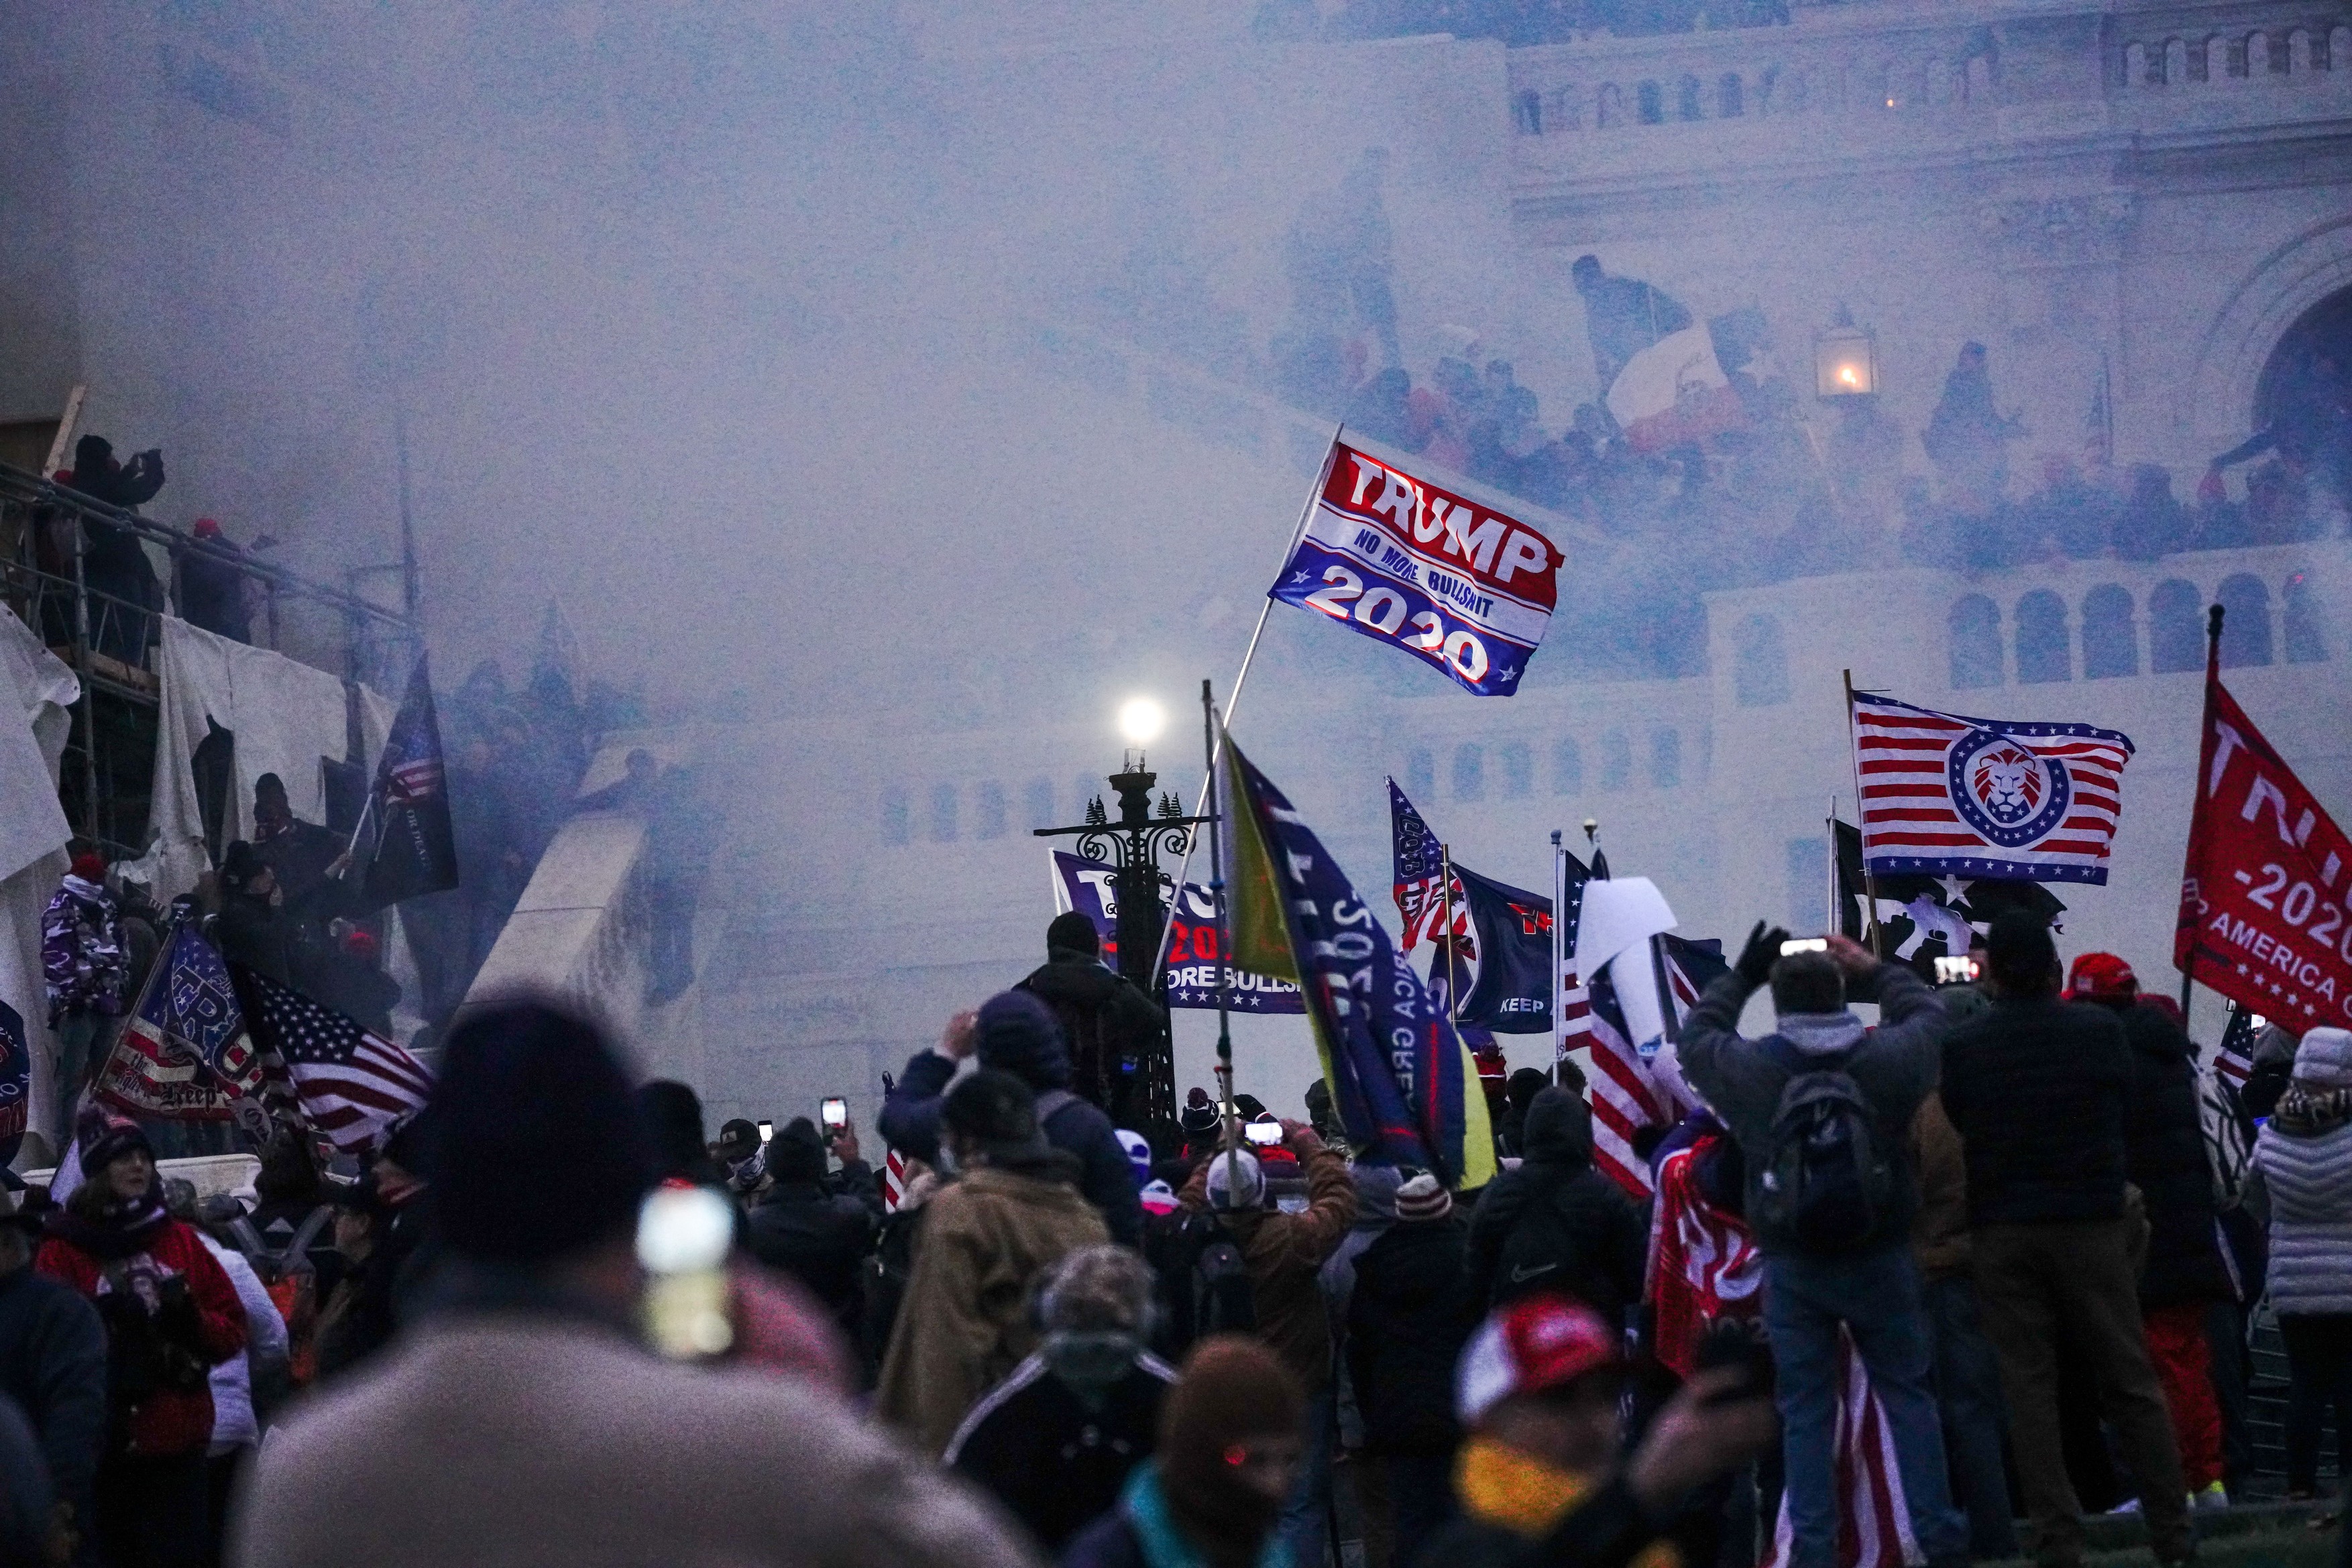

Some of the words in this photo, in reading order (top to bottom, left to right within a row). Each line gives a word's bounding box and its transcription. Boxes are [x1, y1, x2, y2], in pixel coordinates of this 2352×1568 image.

[1351, 452, 1548, 583] TRUMP
[1353, 528, 1377, 555] NO
[1380, 546, 1419, 581] MORE
[1428, 570, 1494, 618] BULLSHIT
[1305, 565, 1488, 682] 2020
[1167, 966, 1216, 989] ORE
[1222, 967, 1301, 993] BULLS
[2210, 911, 2335, 1002] AMERICA
[1500, 998, 1544, 1013] KEEP
